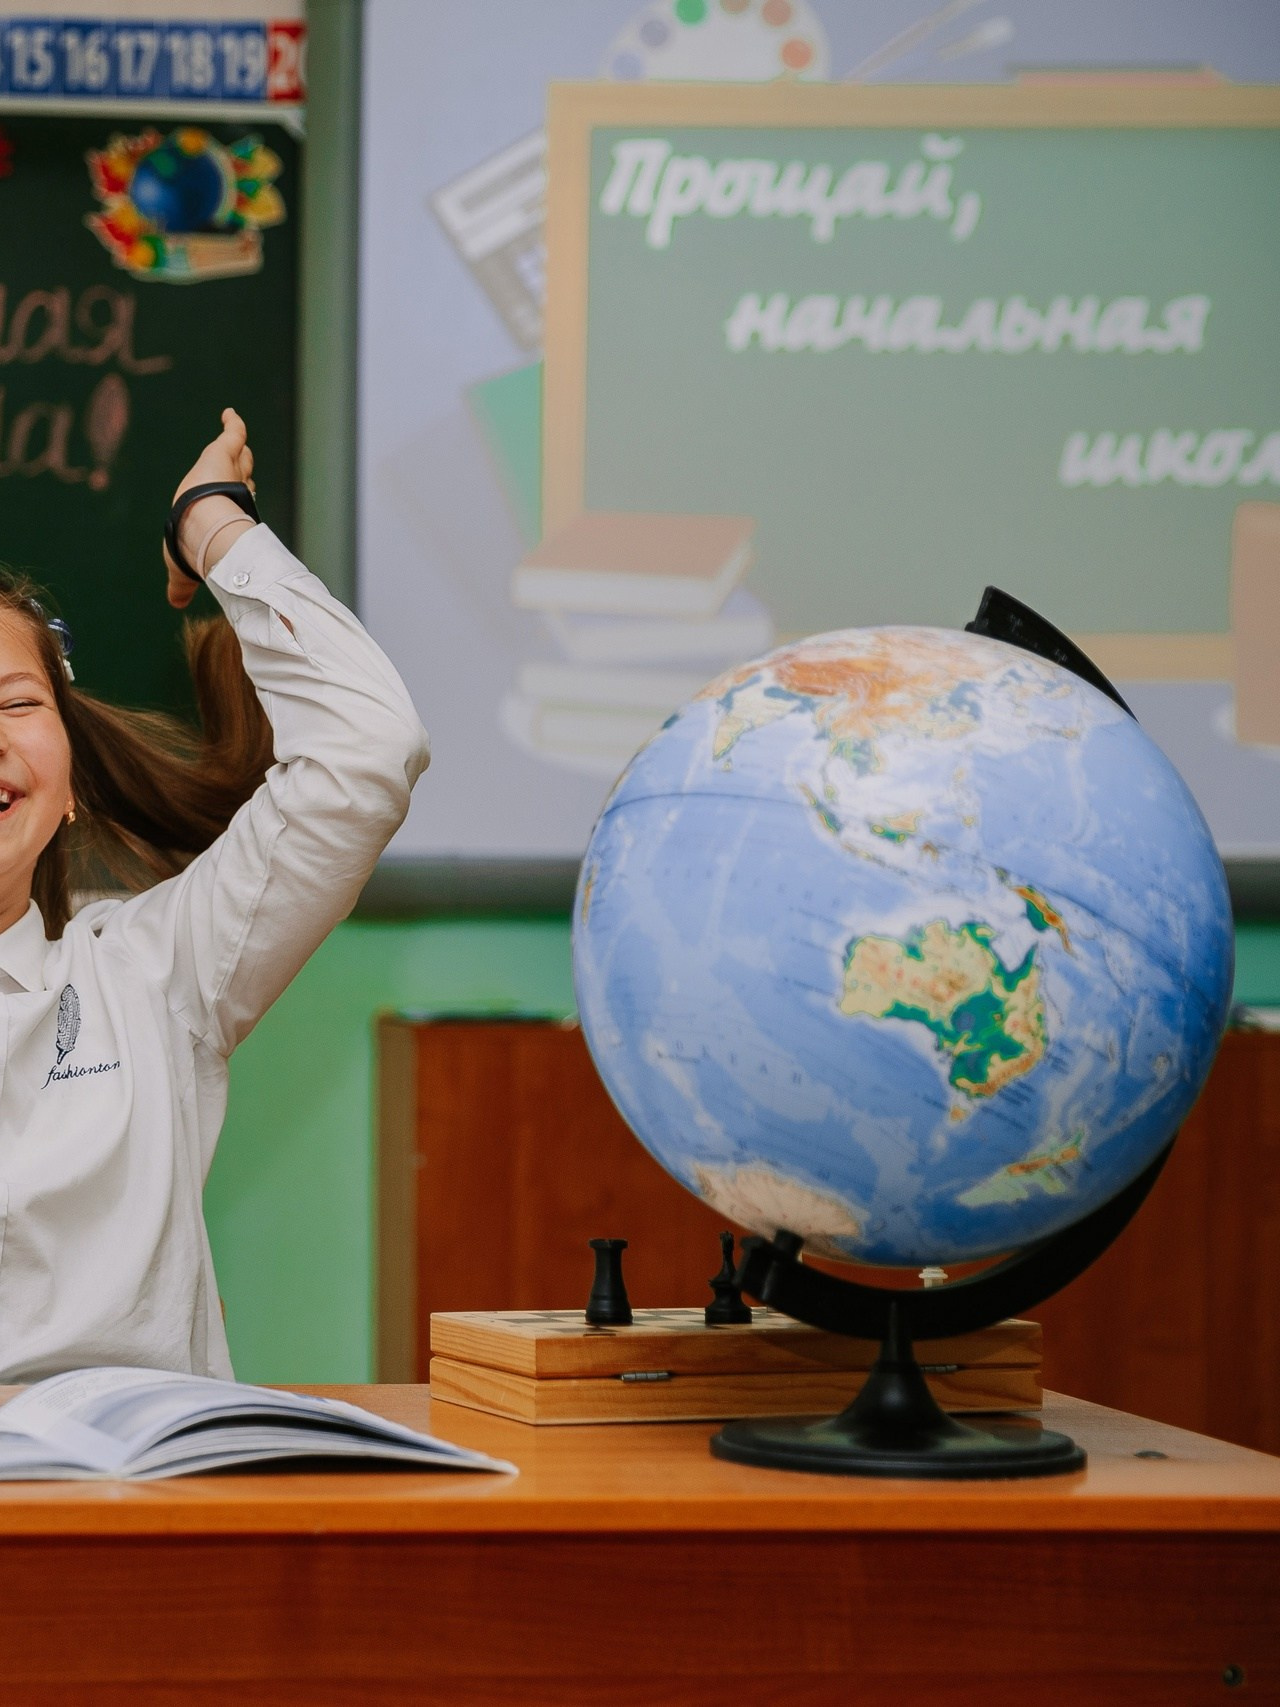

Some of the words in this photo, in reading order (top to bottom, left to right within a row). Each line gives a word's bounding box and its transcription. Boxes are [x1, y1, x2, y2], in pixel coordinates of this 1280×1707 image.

[8, 27, 55, 89] 15
[62, 28, 111, 90] 16
[113, 30, 162, 92] 17
[167, 30, 216, 93] 18
[220, 32, 266, 91] 19
[268, 32, 308, 92] 2
[599, 133, 981, 248] Прощай,
[724, 293, 1211, 353] начальная
